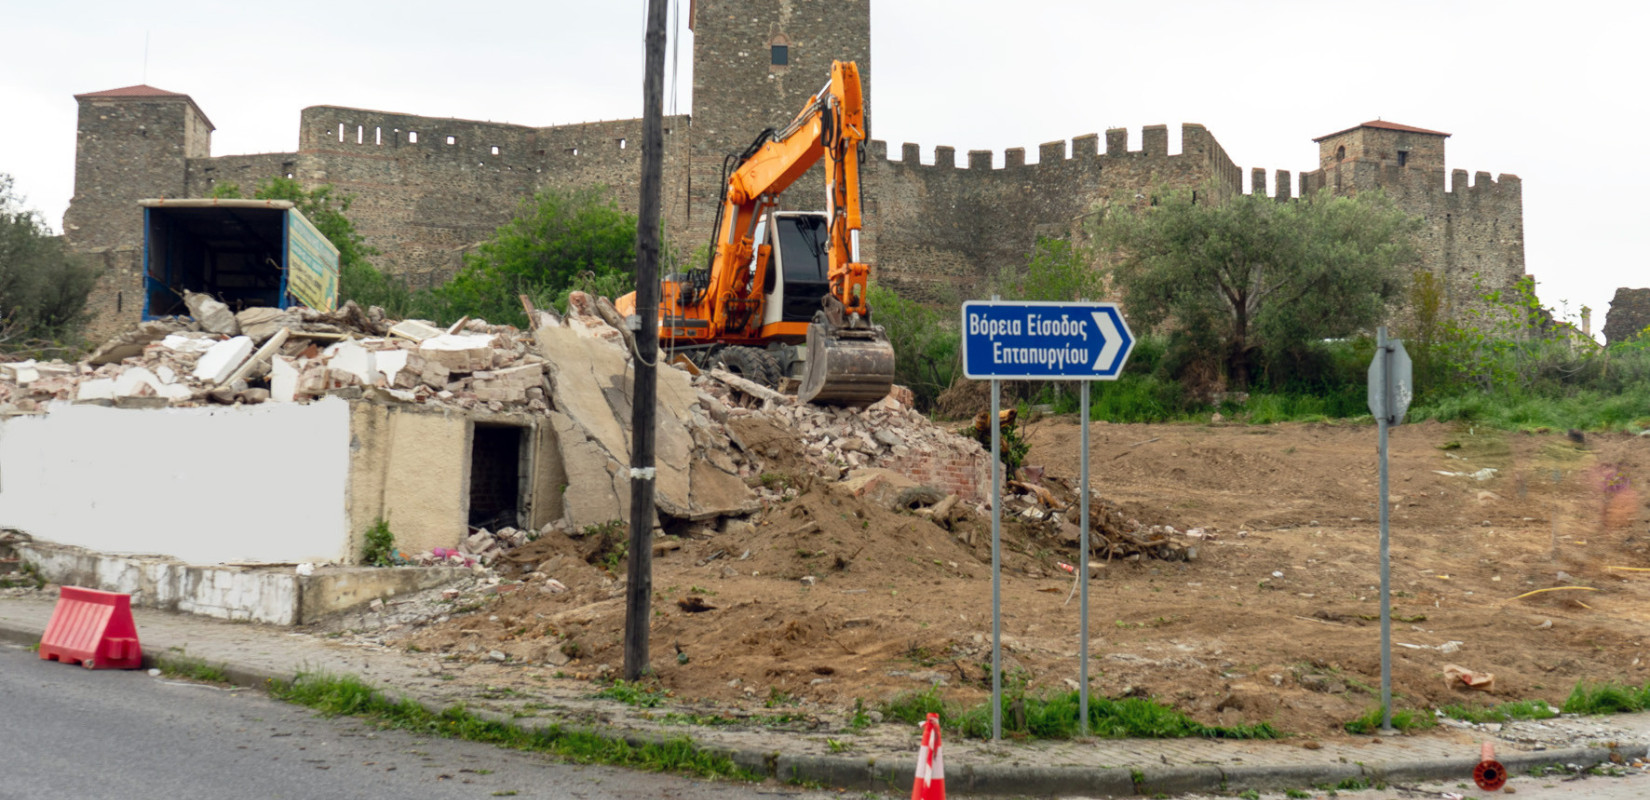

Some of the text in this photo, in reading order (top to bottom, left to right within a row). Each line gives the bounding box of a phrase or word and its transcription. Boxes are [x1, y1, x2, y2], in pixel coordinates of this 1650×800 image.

[970, 313, 1087, 341] Βόρεια Είσοδος
[993, 342, 1088, 370] Επταπυργίου
